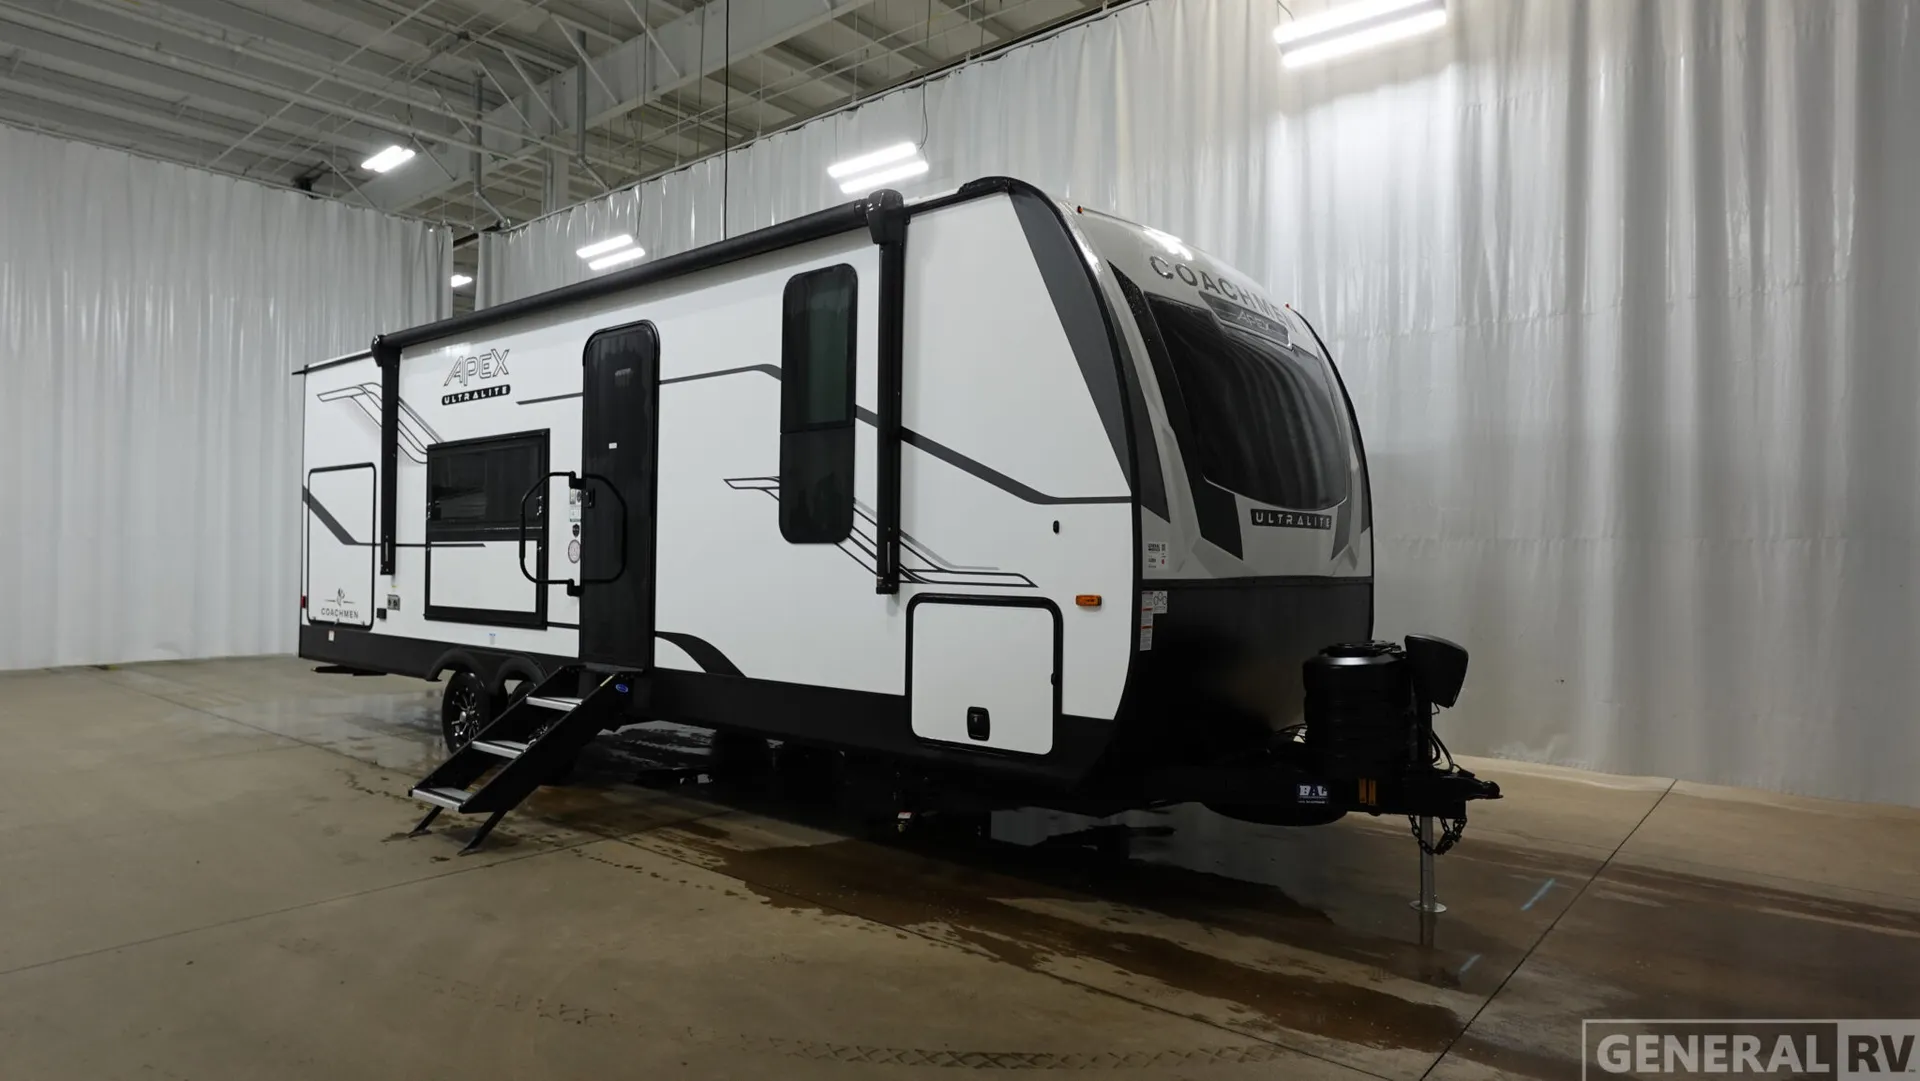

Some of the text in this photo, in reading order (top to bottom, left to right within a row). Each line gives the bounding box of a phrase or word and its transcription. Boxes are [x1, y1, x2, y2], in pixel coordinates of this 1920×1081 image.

[1149, 255, 1298, 334] COACHMEN
[443, 348, 510, 387] APEX
[444, 386, 507, 404] ULTRALITE
[1255, 512, 1331, 528] ULTRALITE
[321, 607, 359, 619] COACHMEN
